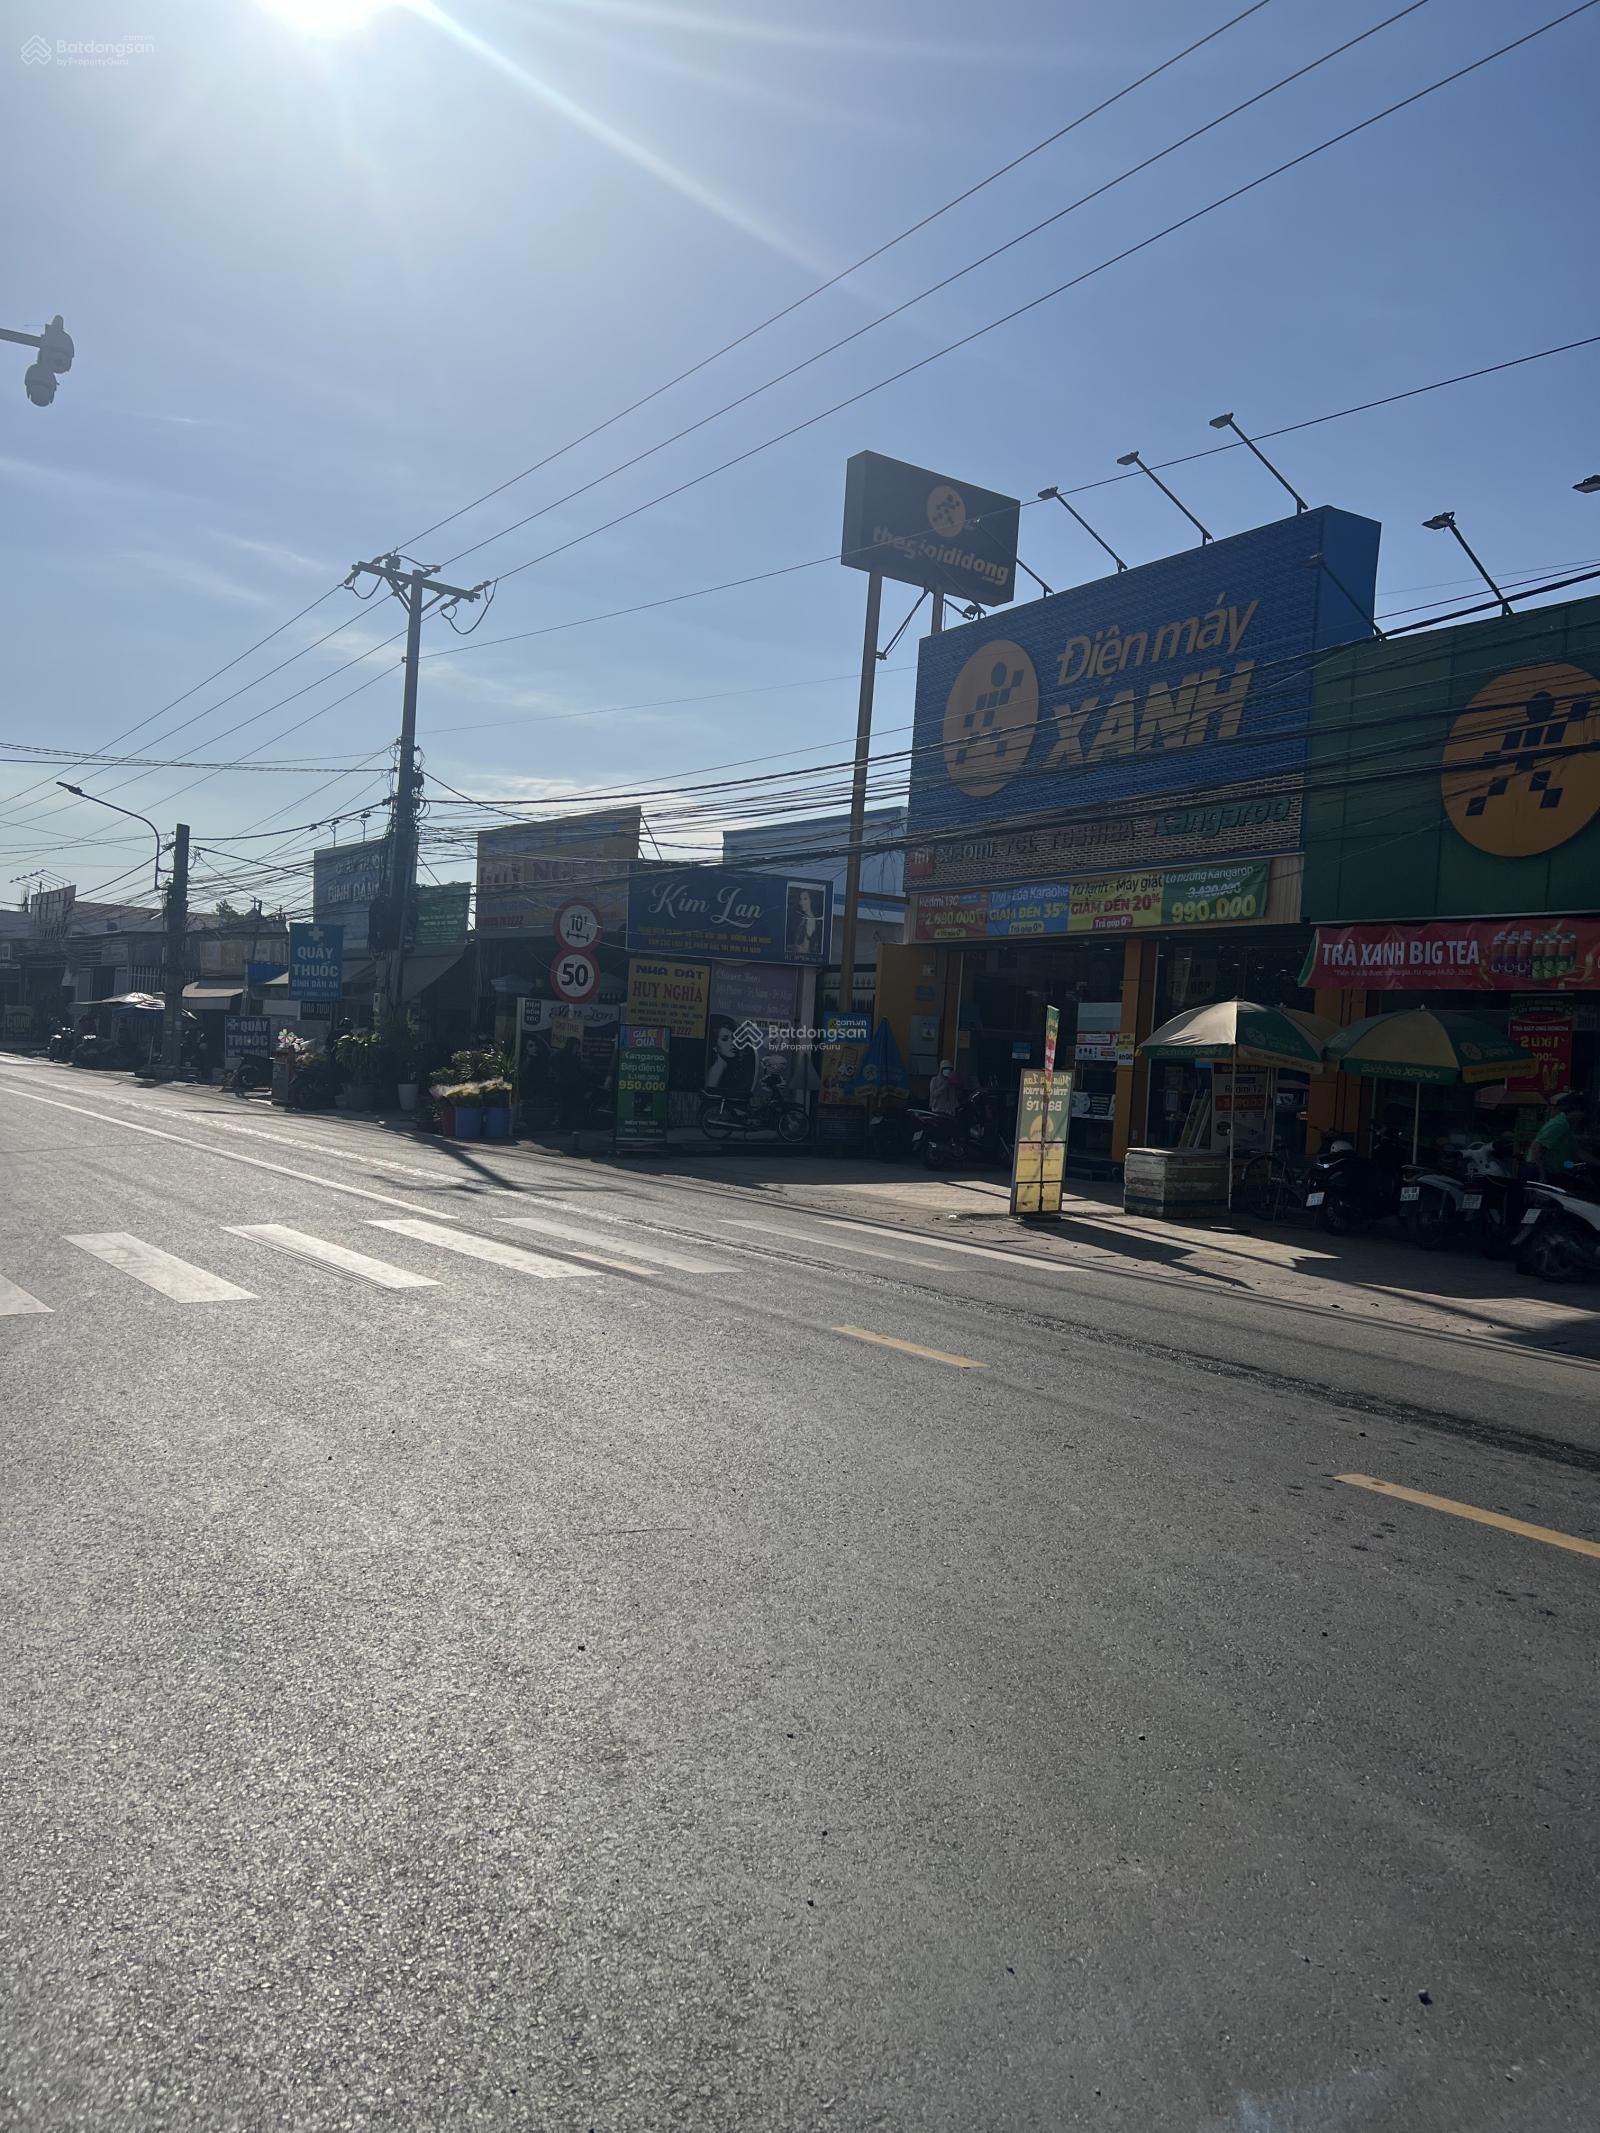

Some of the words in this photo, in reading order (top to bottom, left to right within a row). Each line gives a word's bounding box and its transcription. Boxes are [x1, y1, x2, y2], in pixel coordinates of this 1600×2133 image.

[1056, 623, 1149, 688] Điện
[1151, 591, 1259, 664] máy
[1040, 660, 1258, 768] XANH
[1116, 878, 1139, 893] Máy
[1140, 874, 1163, 892] giặt
[1165, 872, 1175, 884] Lò
[1208, 866, 1254, 881] Kangaroo
[648, 881, 711, 920] Kim
[710, 875, 765, 929] Lan
[1030, 885, 1069, 899] Karaoke
[1071, 897, 1101, 915] GIẢM
[1103, 893, 1129, 912] ĐẾN
[1132, 893, 1161, 912] 20%
[1171, 894, 1257, 922] 990.000
[1322, 938, 1358, 966] TRÀ
[1360, 943, 1405, 966] XANH
[1409, 941, 1443, 966] BIG
[1445, 940, 1480, 966] TEA
[291, 961, 339, 977] THUỐC
[561, 962, 589, 987] 50
[632, 981, 661, 999] HUY
[618, 1080, 666, 1091] 950.000
